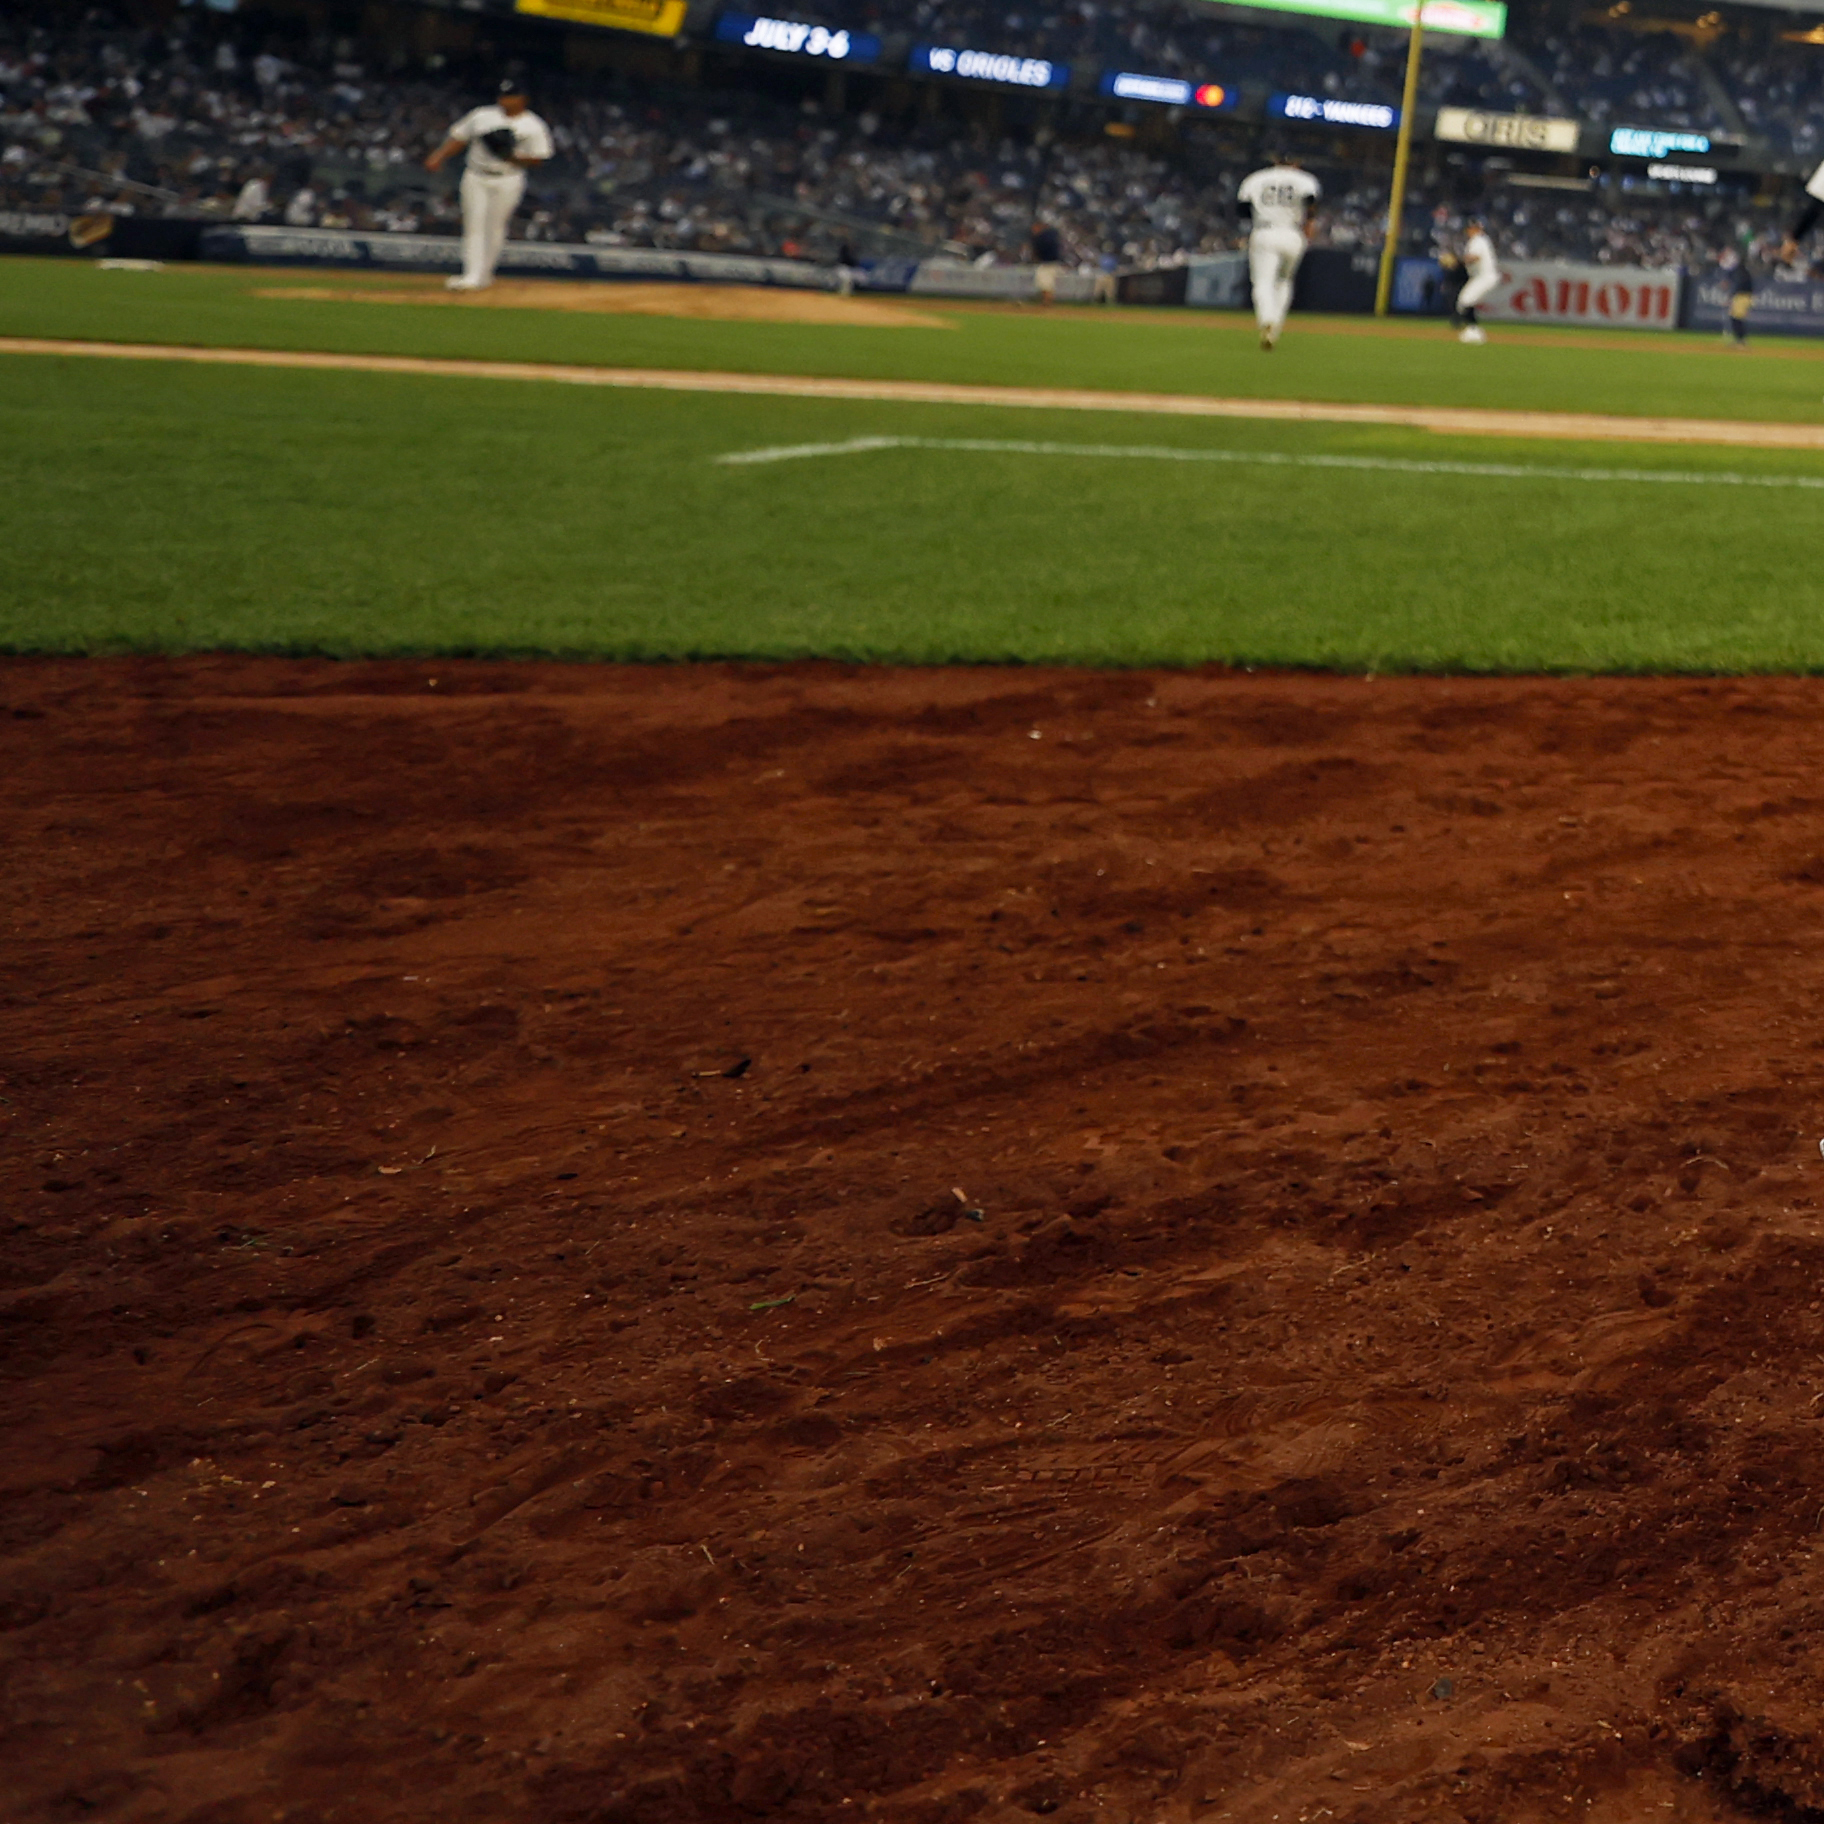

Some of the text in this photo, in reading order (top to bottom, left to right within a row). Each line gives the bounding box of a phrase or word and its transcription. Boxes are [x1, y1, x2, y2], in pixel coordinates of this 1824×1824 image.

[744, 17, 850, 59] JULY 3-6
[956, 49, 1053, 88] ORIOLES
